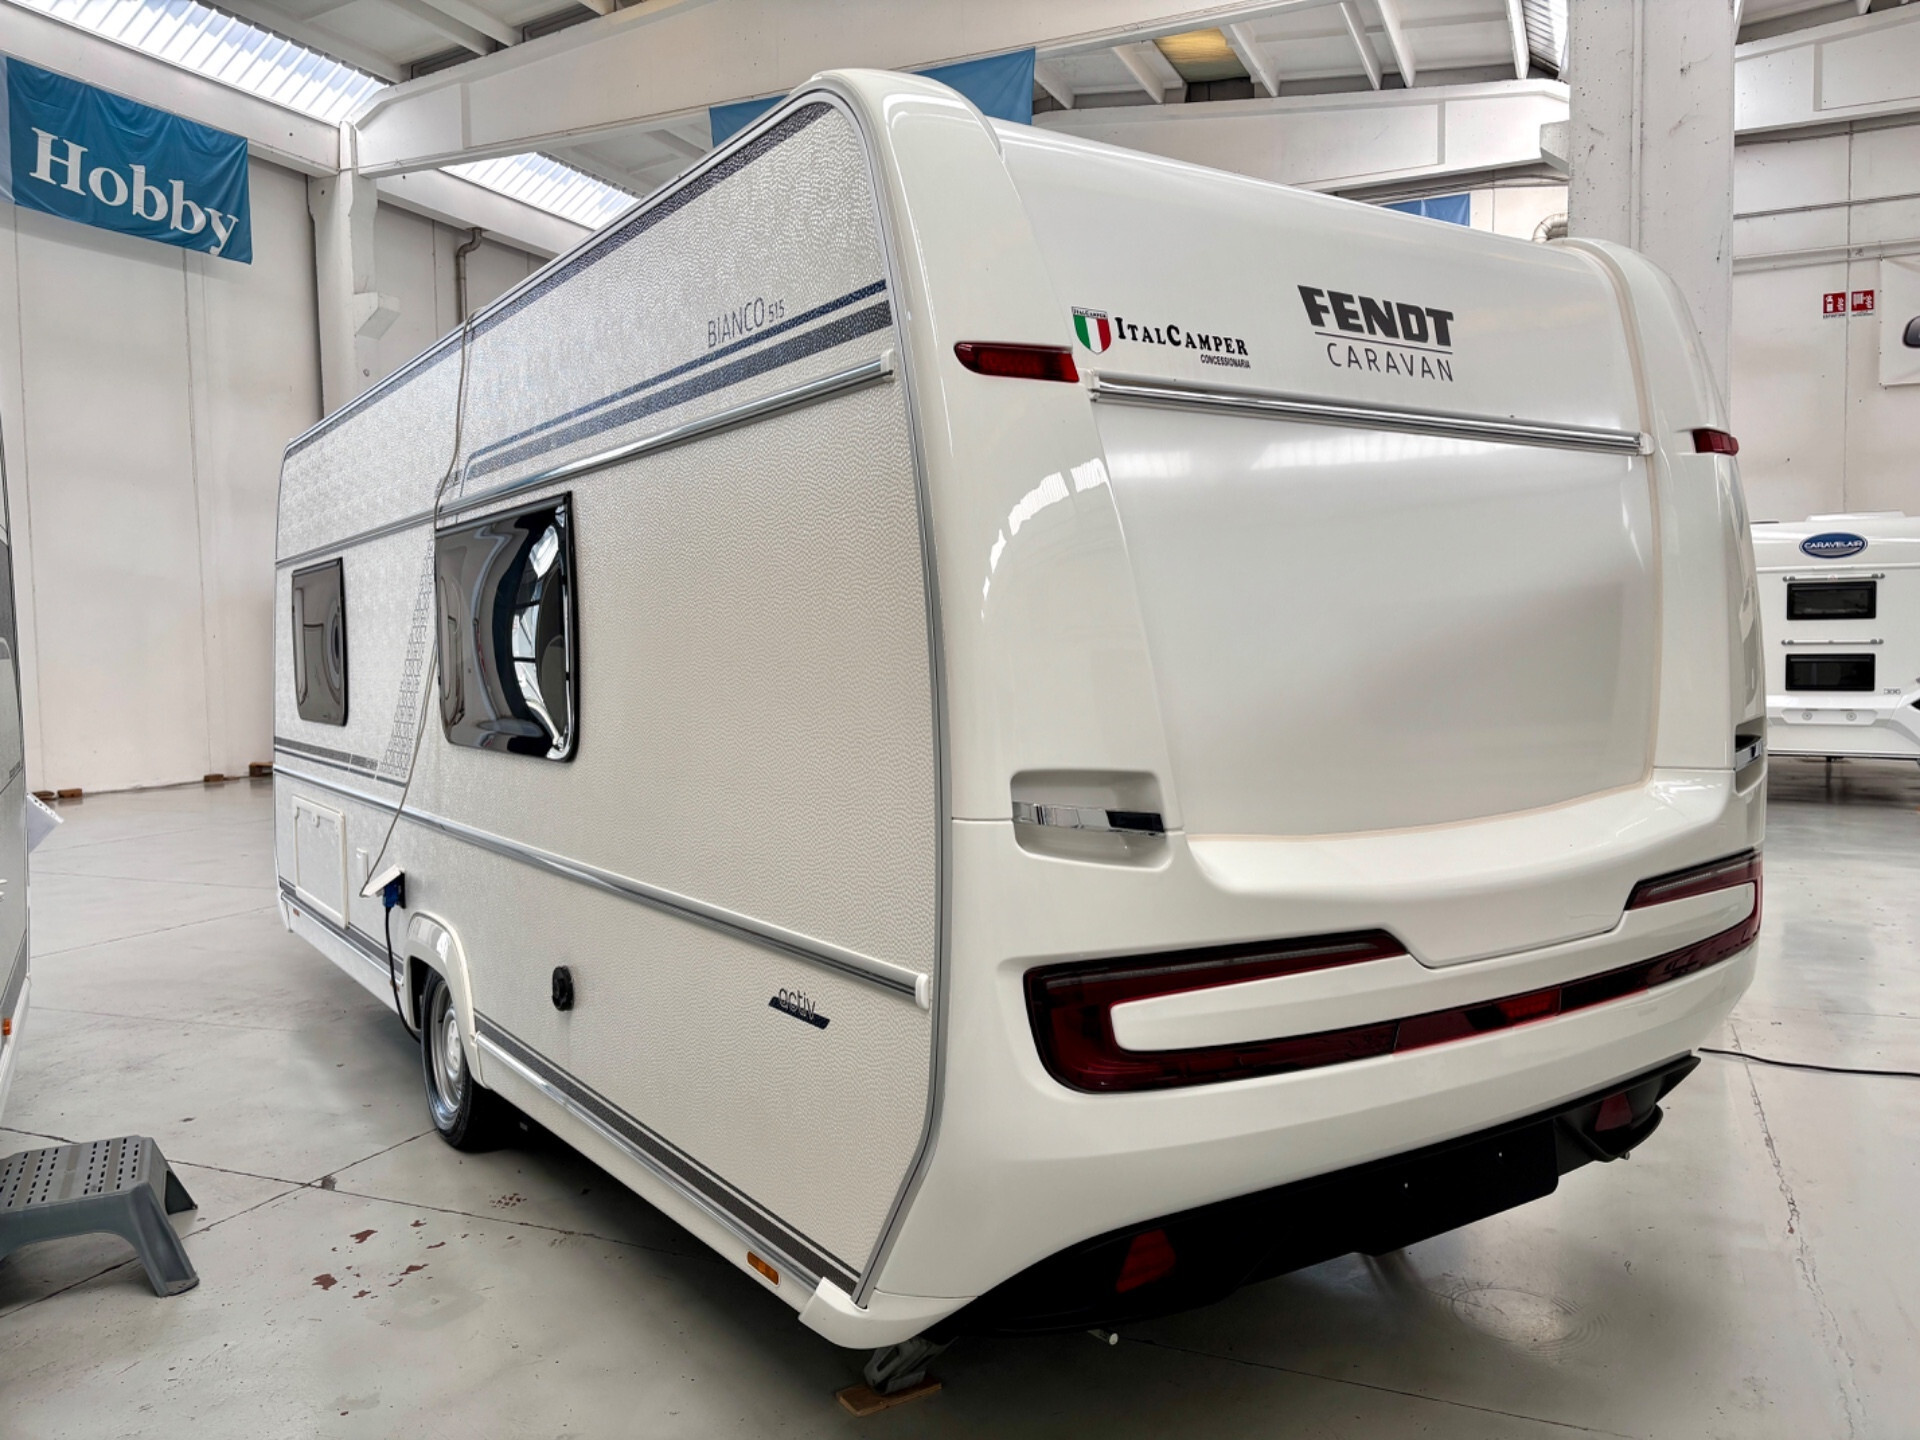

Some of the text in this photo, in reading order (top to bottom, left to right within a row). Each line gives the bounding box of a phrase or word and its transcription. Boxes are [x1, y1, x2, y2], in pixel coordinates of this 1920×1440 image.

[29, 127, 239, 257] Hobby
[707, 297, 785, 348] BIANCO 515
[1297, 284, 1454, 347] FENDT
[1200, 354, 1251, 369] CONCESSIONARIA
[1327, 342, 1453, 382] CARAVAN
[1803, 541, 1863, 549] CARAVELAIR
[779, 988, 816, 1020] activ
